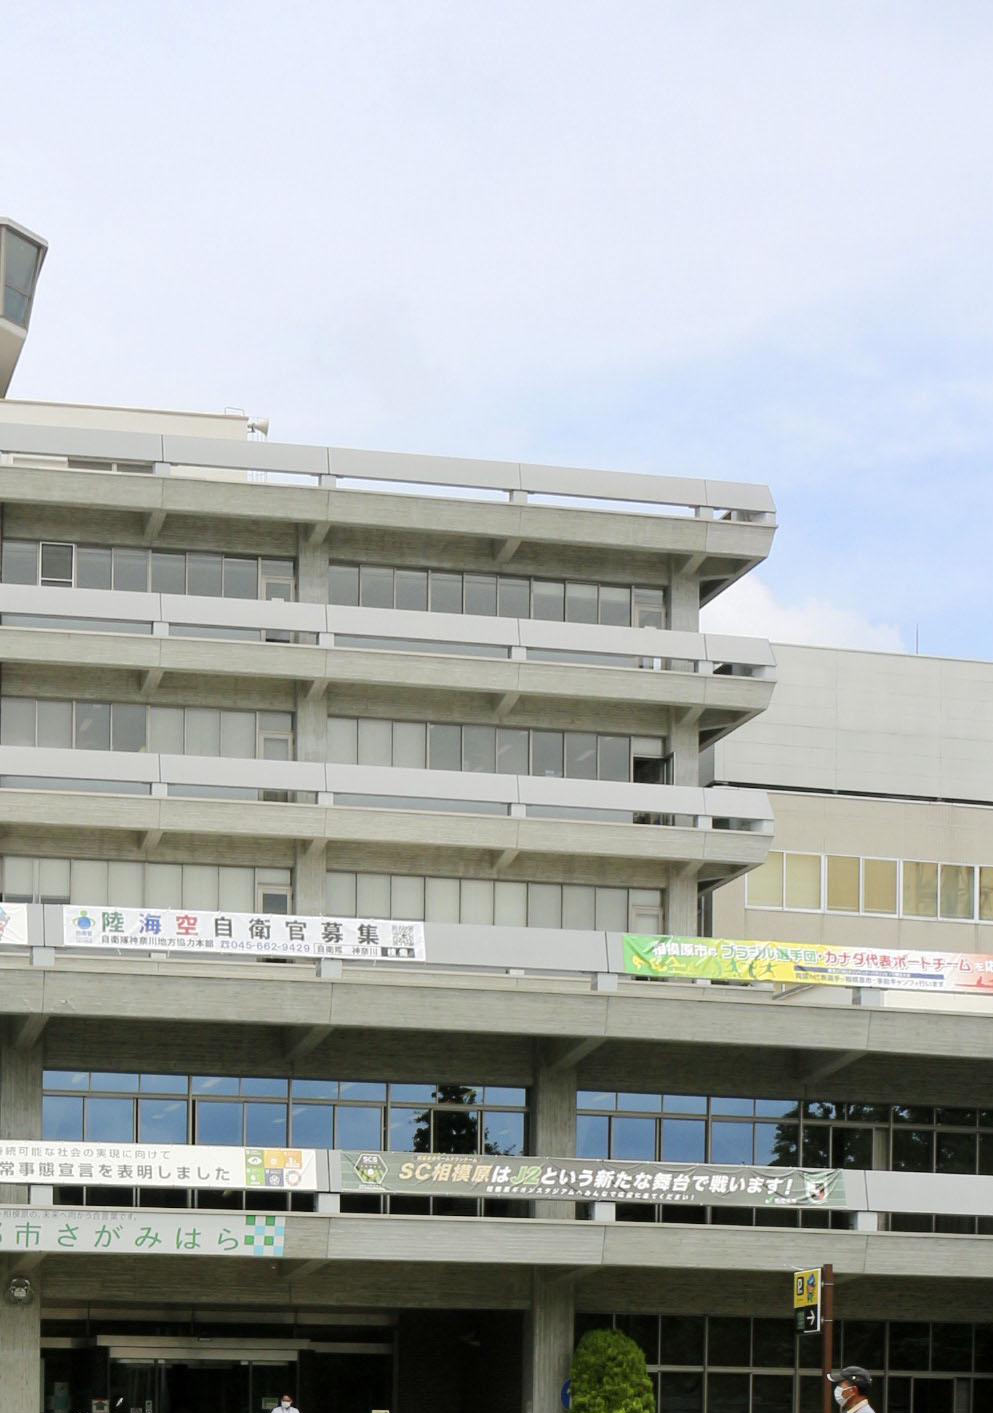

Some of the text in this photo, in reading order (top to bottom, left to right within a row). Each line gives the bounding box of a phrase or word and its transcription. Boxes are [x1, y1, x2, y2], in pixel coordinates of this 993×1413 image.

[101, 910, 380, 945] 陸海空自衛官募集
[100, 935, 214, 949] 自衛隊神奈川地方協力本部
[351, 945, 378, 957] 神奈川
